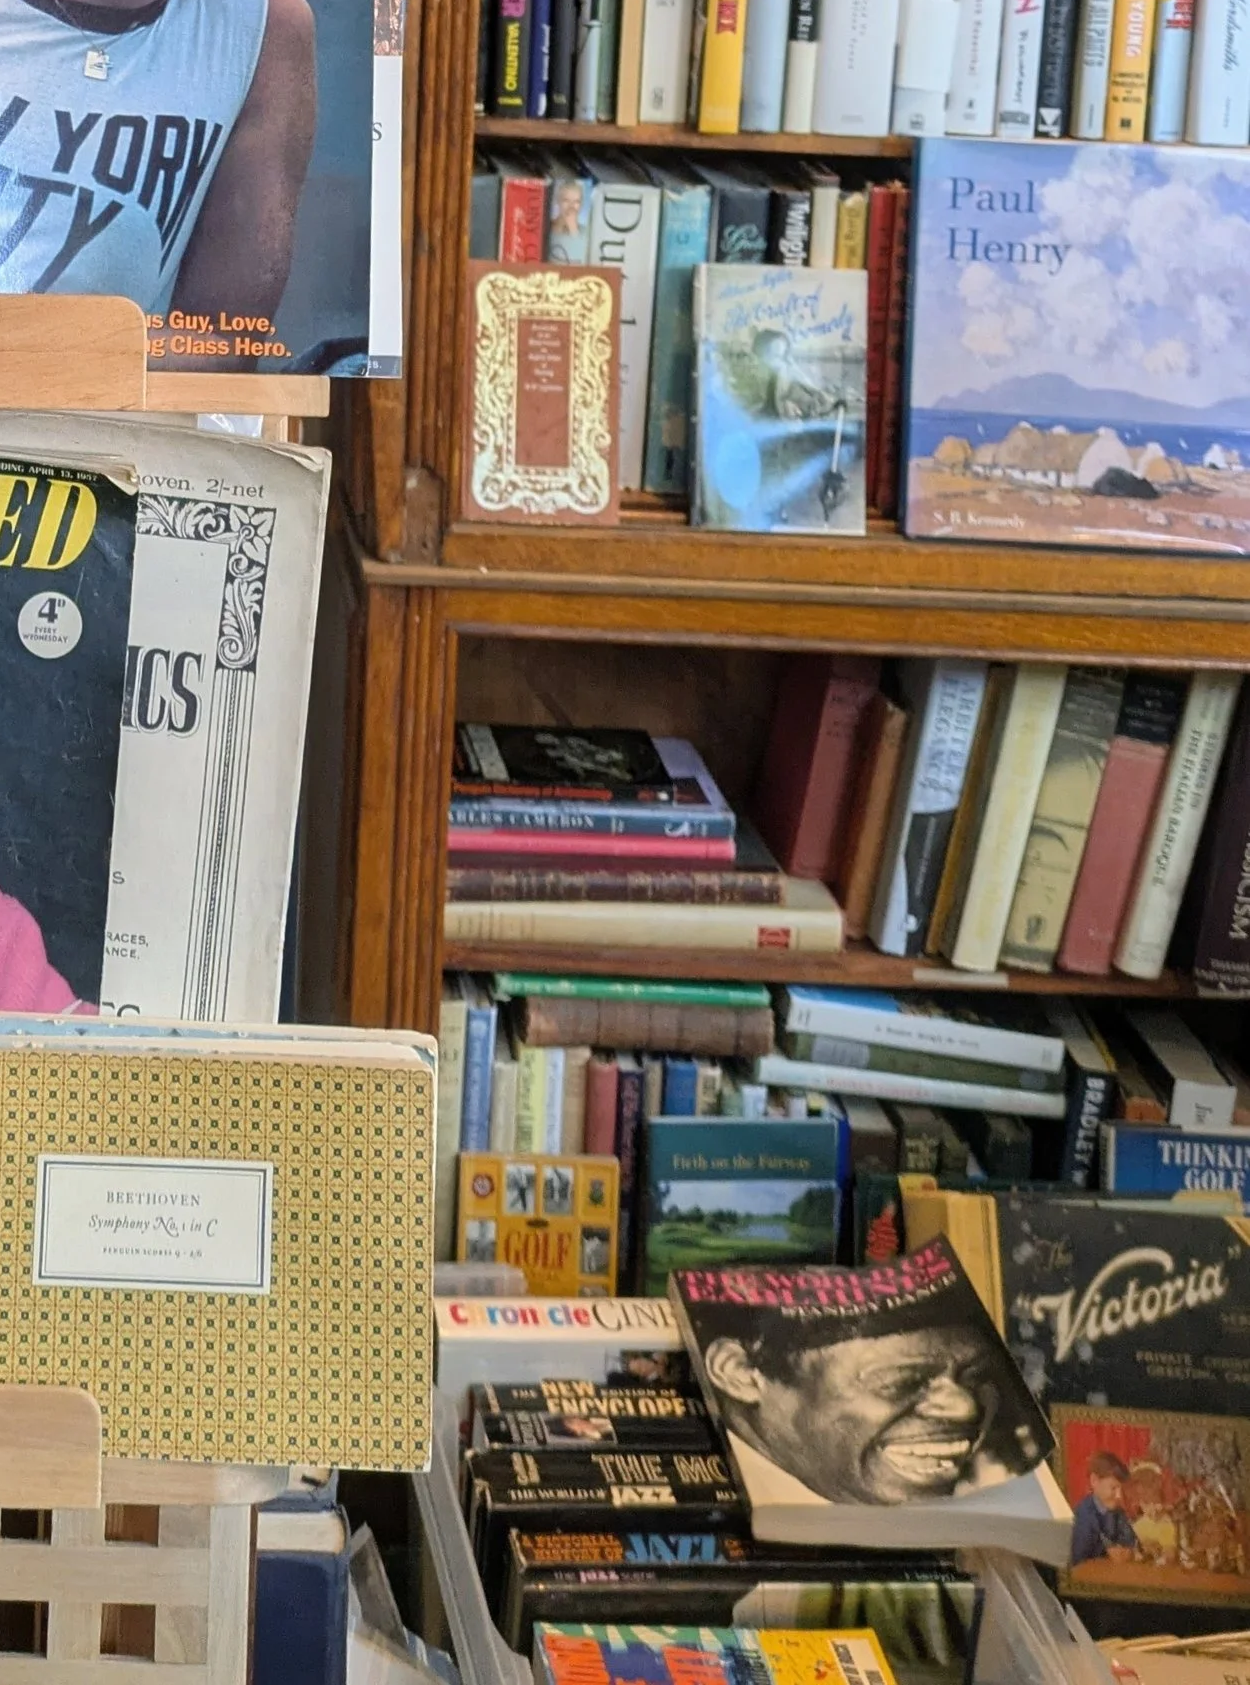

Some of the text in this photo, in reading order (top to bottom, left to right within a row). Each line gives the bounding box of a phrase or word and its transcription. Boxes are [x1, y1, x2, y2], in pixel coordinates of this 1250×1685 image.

[1125, 1, 1144, 57] YOUNG
[503, 22, 521, 91] VALENTINO
[53, 110, 222, 261] YORK
[949, 176, 1036, 214] Paul
[948, 225, 1072, 274] Henry
[169, 310, 276, 336] Guy, Love,
[169, 334, 292, 357] Class Hero.
[28, 465, 55, 477] APRIL
[22, 633, 69, 644] WEDNESDAY
[105, 1190, 202, 1207] BEETHOVEN
[88, 1213, 219, 1238] Symphony C
[101, 1246, 141, 1256] PENGUIN
[503, 1230, 573, 1270] GOLF
[541, 1379, 597, 1397] NEW
[591, 1453, 670, 1484] THE
[609, 1483, 678, 1507] JAZZ
[624, 1532, 717, 1566] JAZZ
